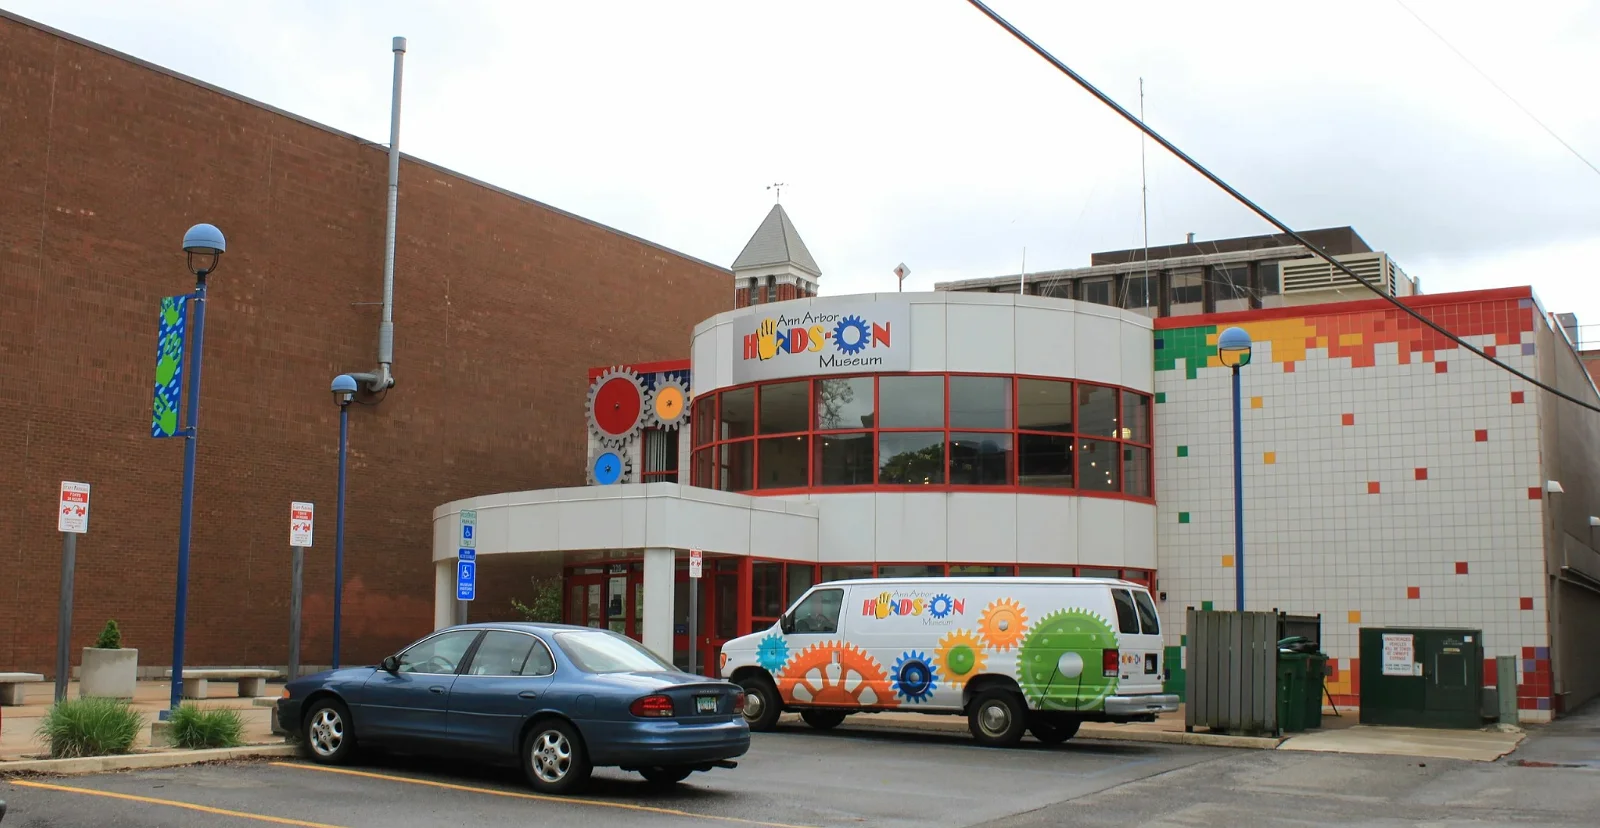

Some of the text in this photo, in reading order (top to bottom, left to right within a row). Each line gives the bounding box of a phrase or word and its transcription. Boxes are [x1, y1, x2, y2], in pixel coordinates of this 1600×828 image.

[777, 311, 840, 327] Ann Arbor
[819, 354, 882, 368] Museum
[891, 589, 934, 598] Ann Arbor
[922, 618, 953, 626] Museum
